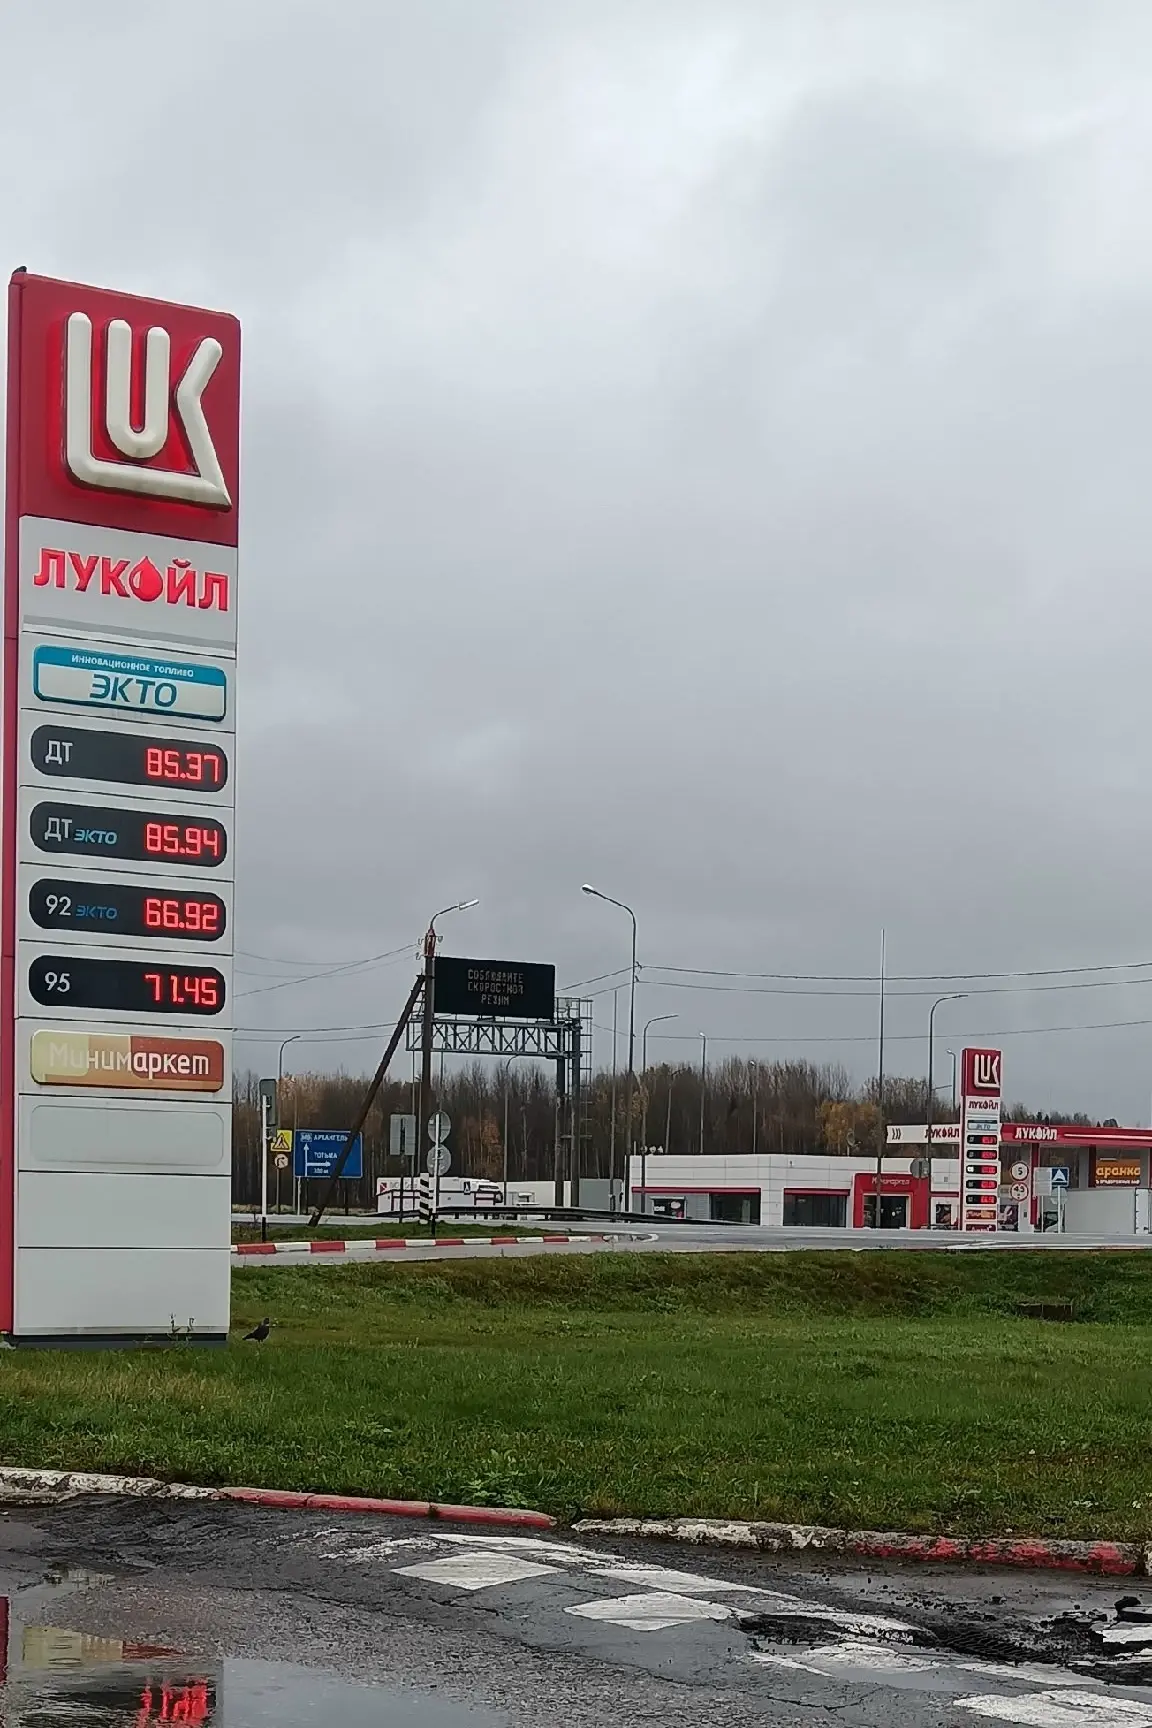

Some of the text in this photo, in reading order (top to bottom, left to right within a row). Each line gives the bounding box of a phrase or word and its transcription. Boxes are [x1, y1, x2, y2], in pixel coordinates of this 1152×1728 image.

[33, 547, 229, 612] ЛУКОЙЛ
[71, 654, 194, 678] ИННОВАЦИОННОЕ ТОПЛИВО
[89, 674, 177, 708] ЭКТО
[45, 740, 219, 783] ДТ 85.37
[44, 817, 218, 857] ДТ ЭКТО 85.94
[45, 894, 217, 931] 92 ЭКТО 66.92
[44, 971, 71, 993] 95
[49, 1042, 209, 1080] Минимаркет
[1015, 1126, 1058, 1140] ЛУКОЙЛ
